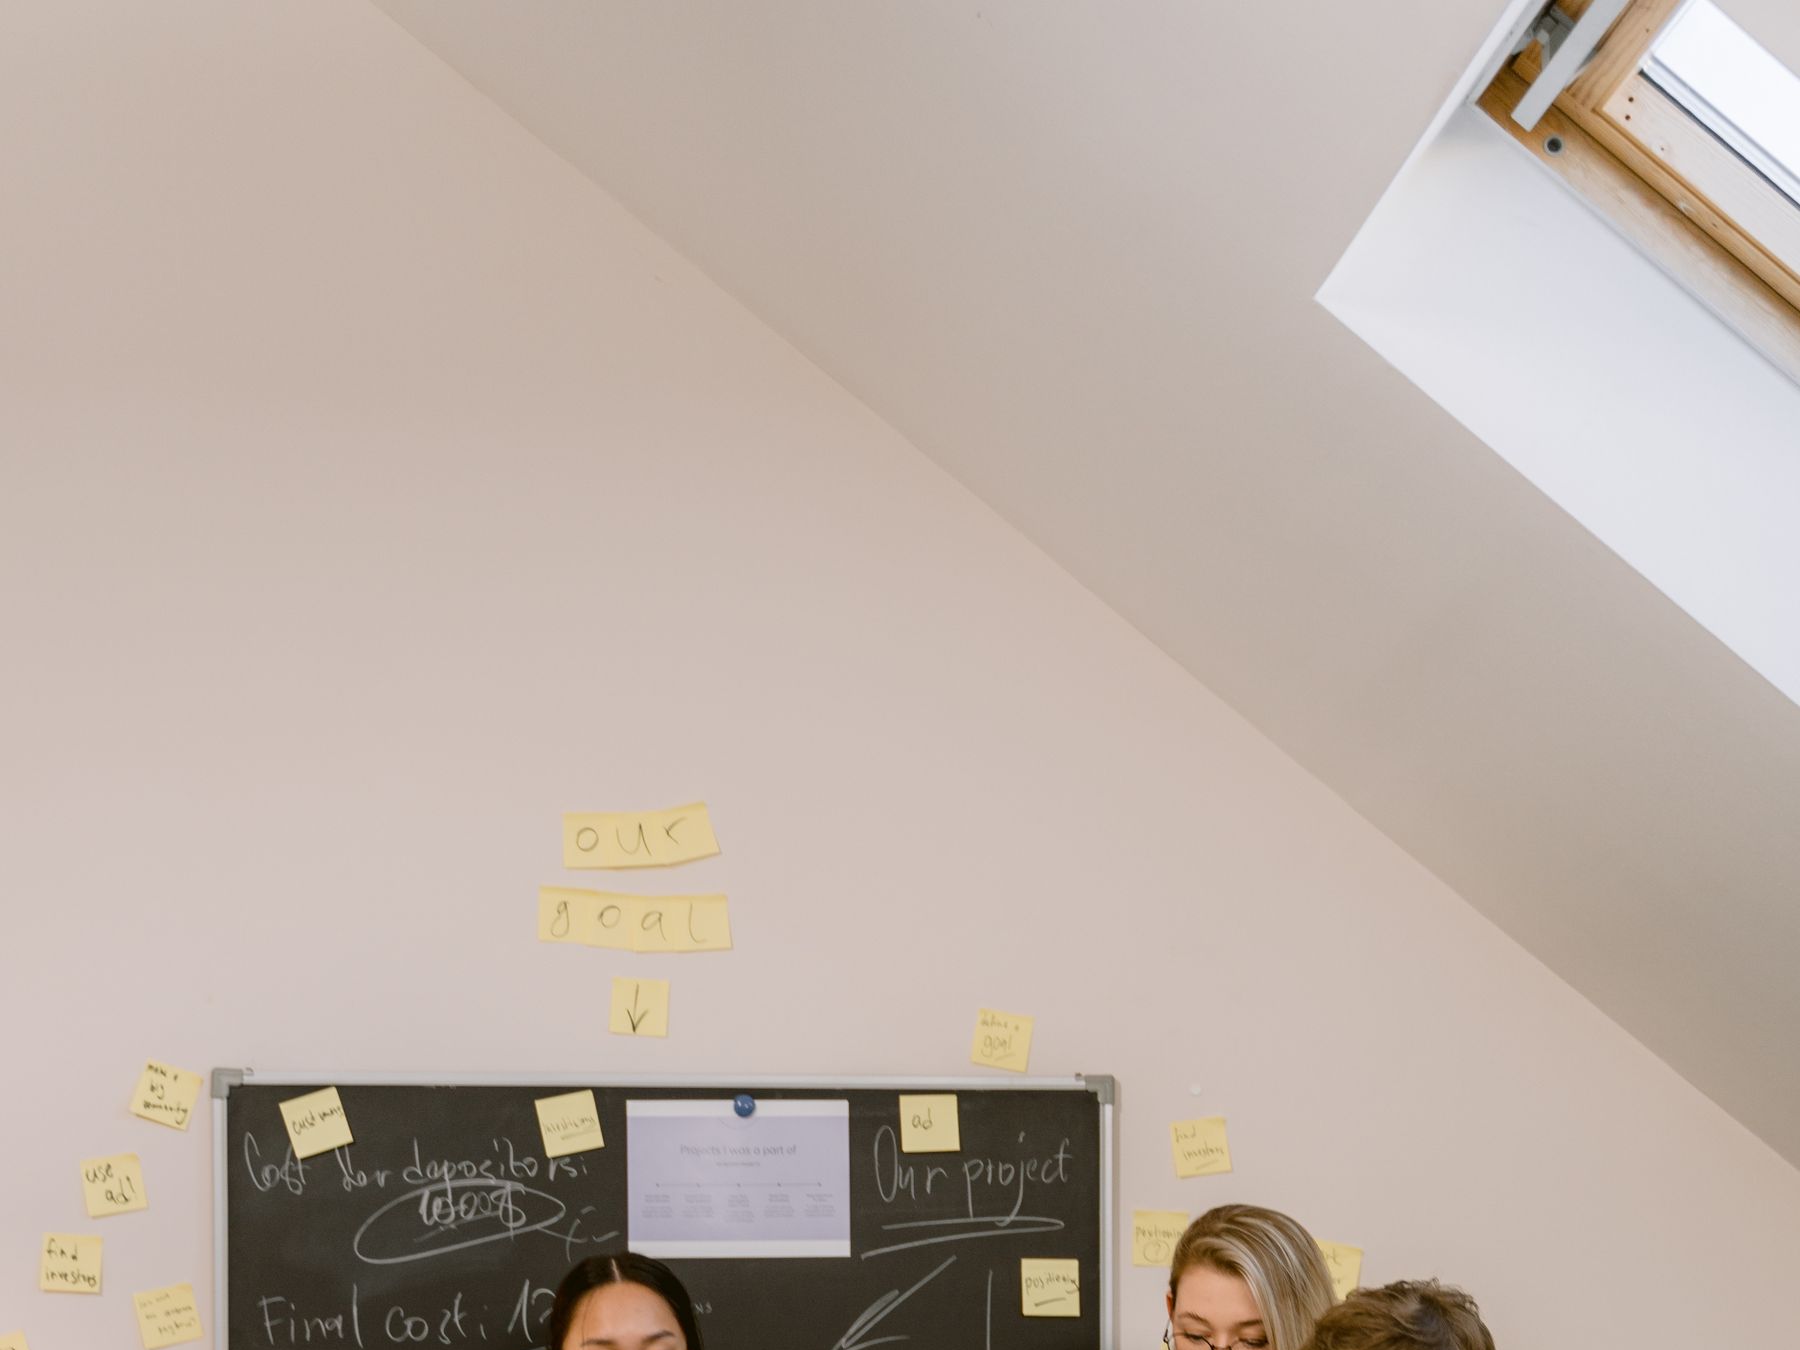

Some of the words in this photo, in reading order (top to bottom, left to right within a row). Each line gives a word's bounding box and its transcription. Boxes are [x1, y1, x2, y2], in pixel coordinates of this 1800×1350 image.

[575, 815, 689, 857] our
[550, 900, 708, 944] goal
[980, 1034, 1013, 1058] goal
[911, 1108, 933, 1130] ad
[680, 1143, 721, 1157] Projects
[727, 1145, 751, 1156] was
[753, 1145, 761, 1155] a
[762, 1144, 784, 1157] part
[785, 1143, 797, 1156] of
[85, 1163, 114, 1184] use
[874, 1125, 949, 1203] Our
[961, 1131, 1073, 1227] project
[47, 1238, 79, 1262] find
[256, 1283, 363, 1349] Final
